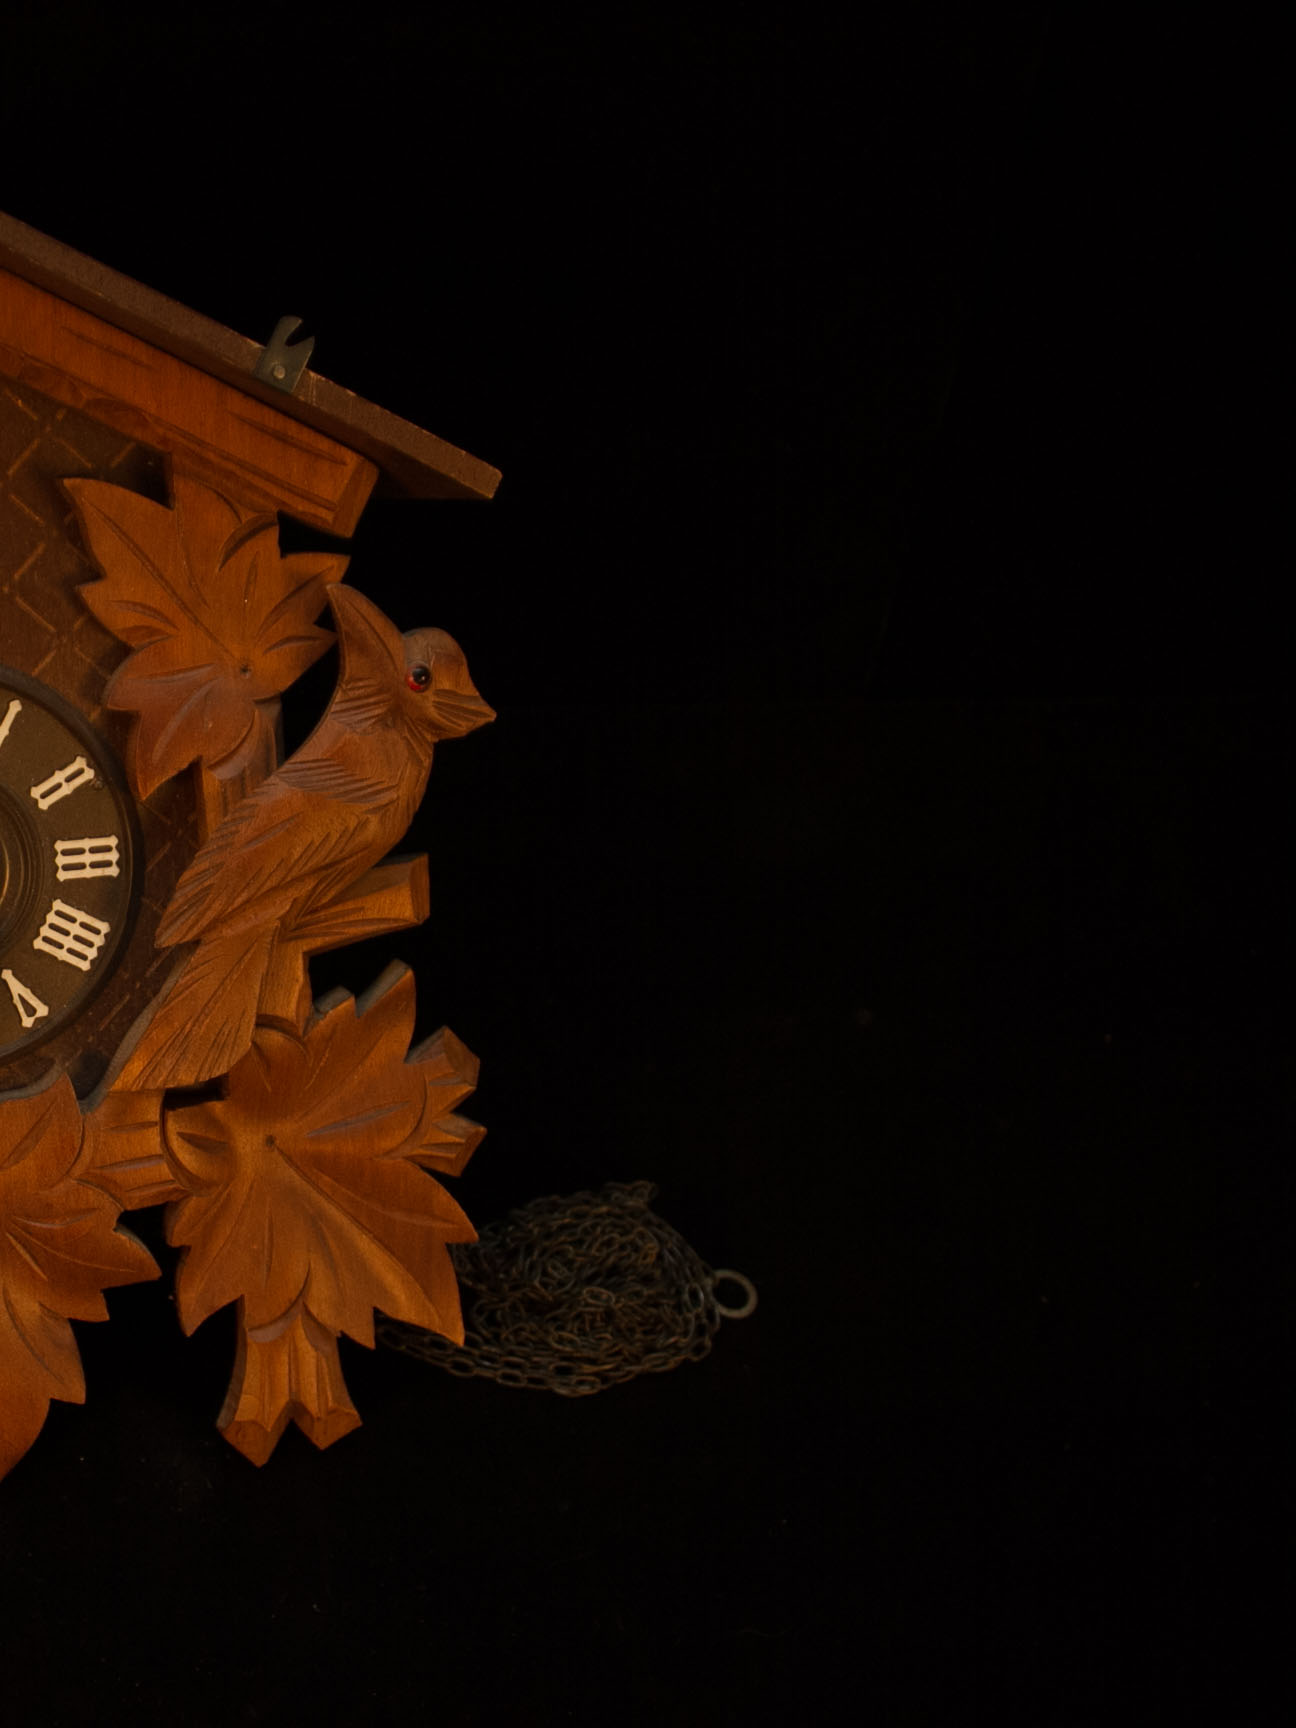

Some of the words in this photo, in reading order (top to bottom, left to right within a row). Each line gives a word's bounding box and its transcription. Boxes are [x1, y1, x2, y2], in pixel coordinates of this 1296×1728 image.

[30, 755, 96, 811] II
[54, 834, 121, 883] III
[32, 898, 111, 972] IIII
[0, 968, 50, 1029] V
